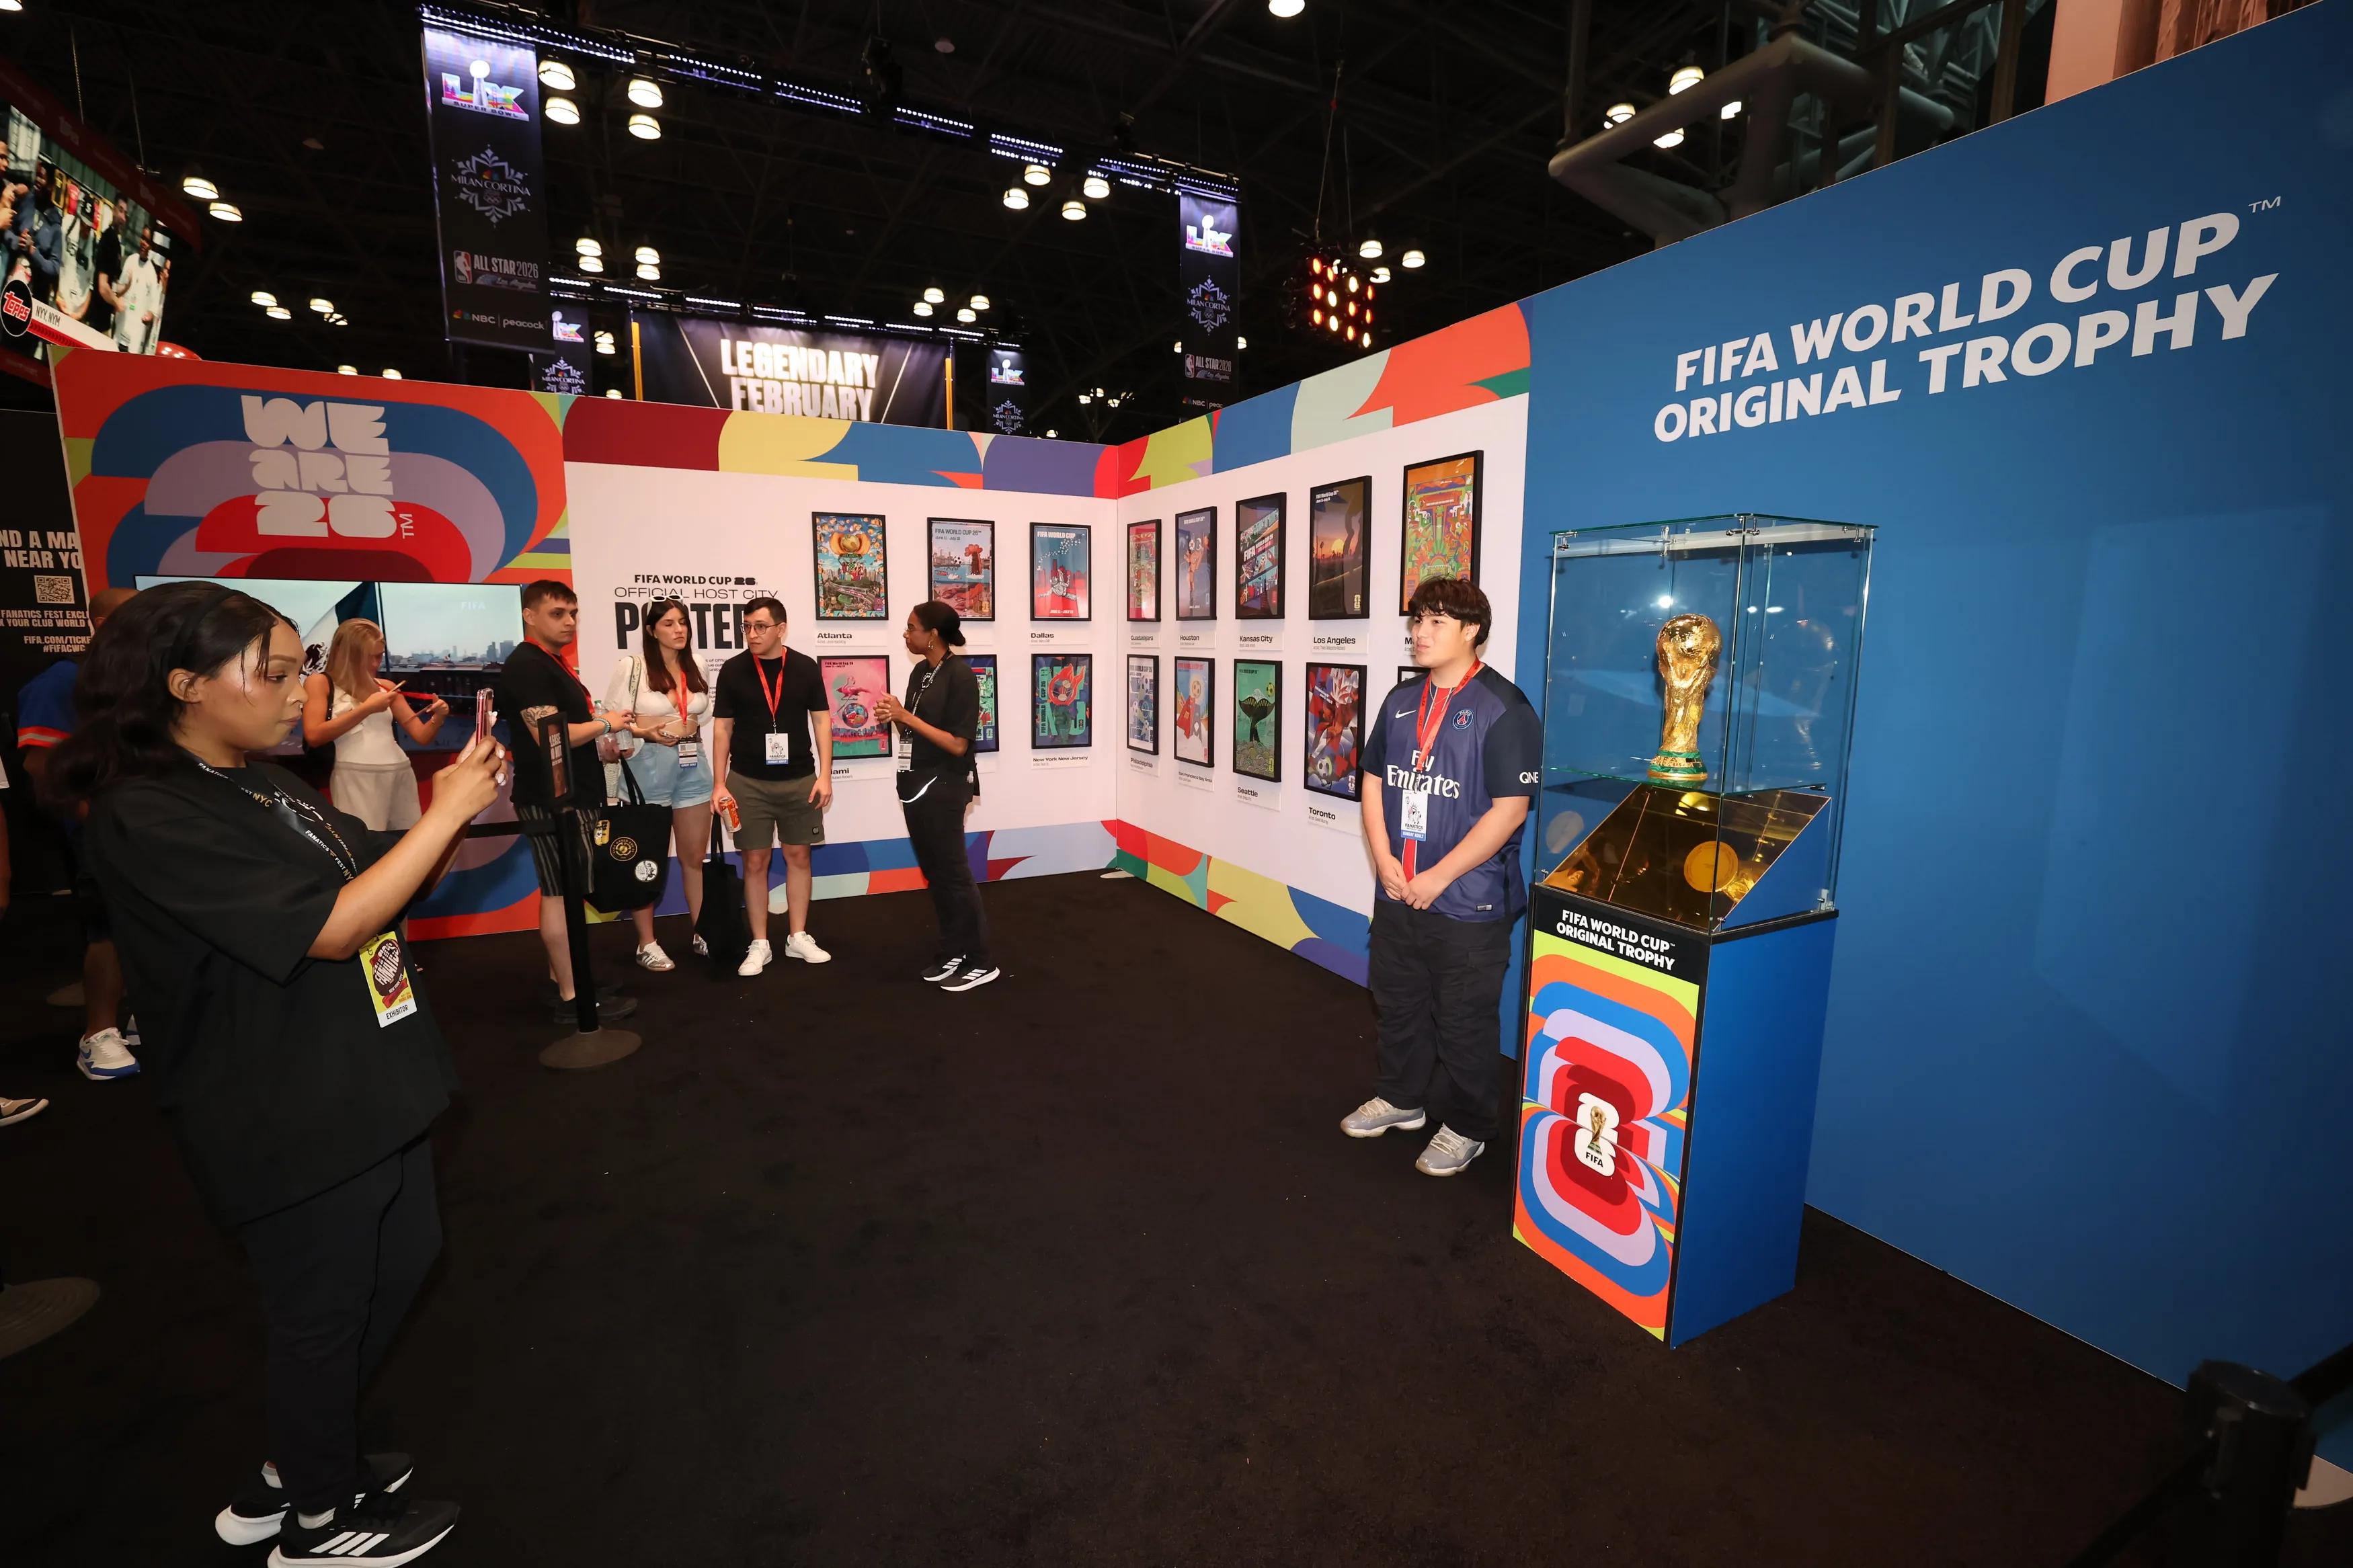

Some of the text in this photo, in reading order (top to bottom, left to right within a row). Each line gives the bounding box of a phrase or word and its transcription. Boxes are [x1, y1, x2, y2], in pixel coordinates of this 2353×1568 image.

[453, 101, 518, 118] SUPER BOWL
[451, 174, 531, 196] MILAN CORTINA
[473, 254, 539, 279] ALL STAR 2026
[1675, 331, 1779, 392] FIFA
[1790, 268, 2032, 366] WORLD
[2050, 212, 2239, 304] CUP
[36, 305, 61, 327] NYY, NYM
[472, 313, 545, 330] NBC peacock
[720, 339, 879, 388] LEGENDARY
[1195, 355, 1205, 368] ALL
[1205, 356, 1220, 370] STAR
[1654, 272, 2279, 442] ORIGINAL TROPHY
[730, 376, 873, 421] FEBRUARY
[1192, 399, 1205, 407] NBC
[241, 395, 390, 456] WE
[254, 490, 397, 538] 26
[0, 530, 78, 550] ND A MA
[4, 550, 81, 569] NEAR YO
[1244, 548, 1256, 562] FIFA
[635, 575, 661, 583] FIFA
[662, 575, 706, 585] WORLD
[709, 576, 731, 585] CUP
[614, 587, 779, 600] OFFICIAL HOST CITY
[1, 610, 42, 619] FANATICS
[44, 610, 63, 619] FEST
[7, 619, 30, 627] YOUR
[32, 619, 53, 627] CLUB
[55, 619, 85, 628] WORLD
[24, 635, 91, 645] FIFA.COM/TICKE
[1261, 635, 1273, 643] City
[1326, 636, 1356, 645] Angeles
[42, 644, 86, 653] #FIFACWC
[1130, 757, 1153, 768] Philadelphia
[1411, 749, 1435, 772] Fy
[1387, 764, 1461, 800] Emirates
[252, 792, 272, 807] NYC
[1237, 786, 1259, 797] Seattle
[1308, 807, 1336, 820] Toronto
[305, 830, 354, 882] FANATICS FEST NY
[1562, 909, 1588, 928] FIFA
[1590, 917, 1639, 943] WORLD
[1556, 921, 1675, 971] ORIGINAL TROPHY
[386, 1004, 409, 1020] EXHIBITOR
[1585, 1151, 1603, 1168] FIFA
